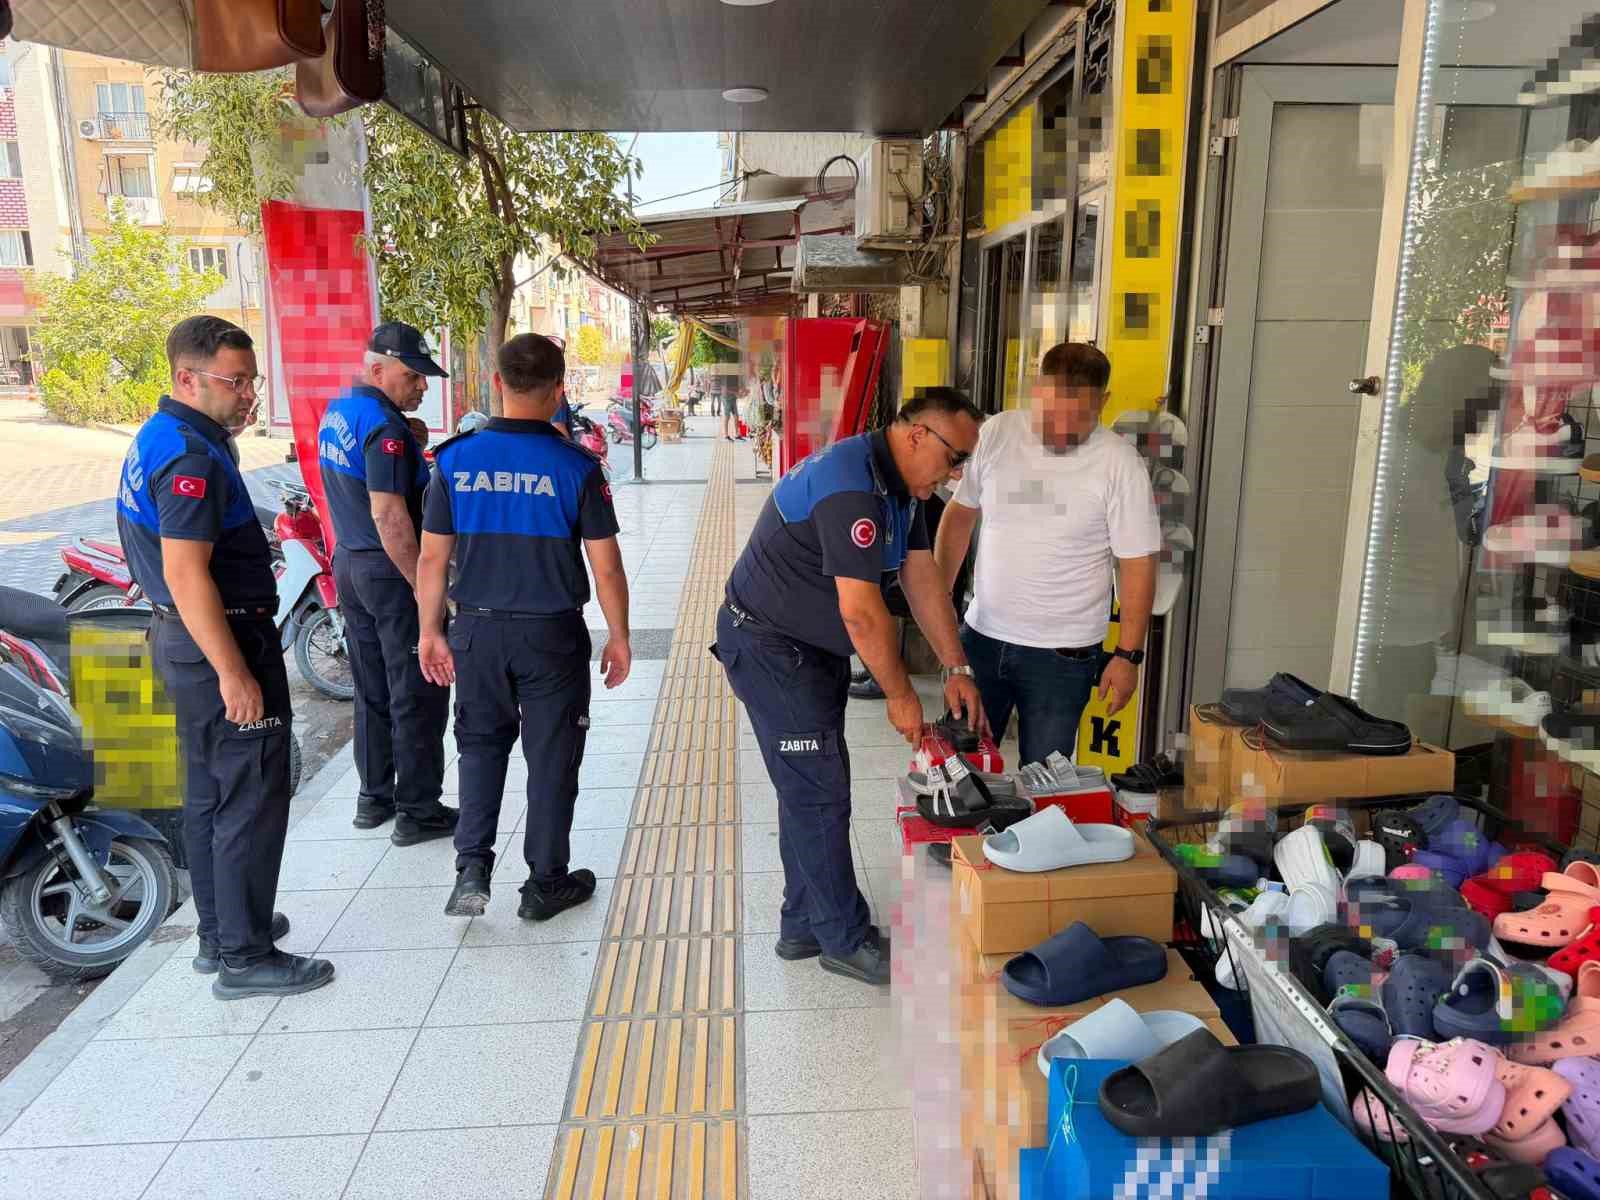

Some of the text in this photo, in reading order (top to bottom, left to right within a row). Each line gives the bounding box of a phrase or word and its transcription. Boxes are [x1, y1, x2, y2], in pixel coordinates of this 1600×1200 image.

[453, 471, 556, 497] ZABITA
[238, 717, 283, 732] ZABITA
[779, 739, 820, 752] ZABITA
